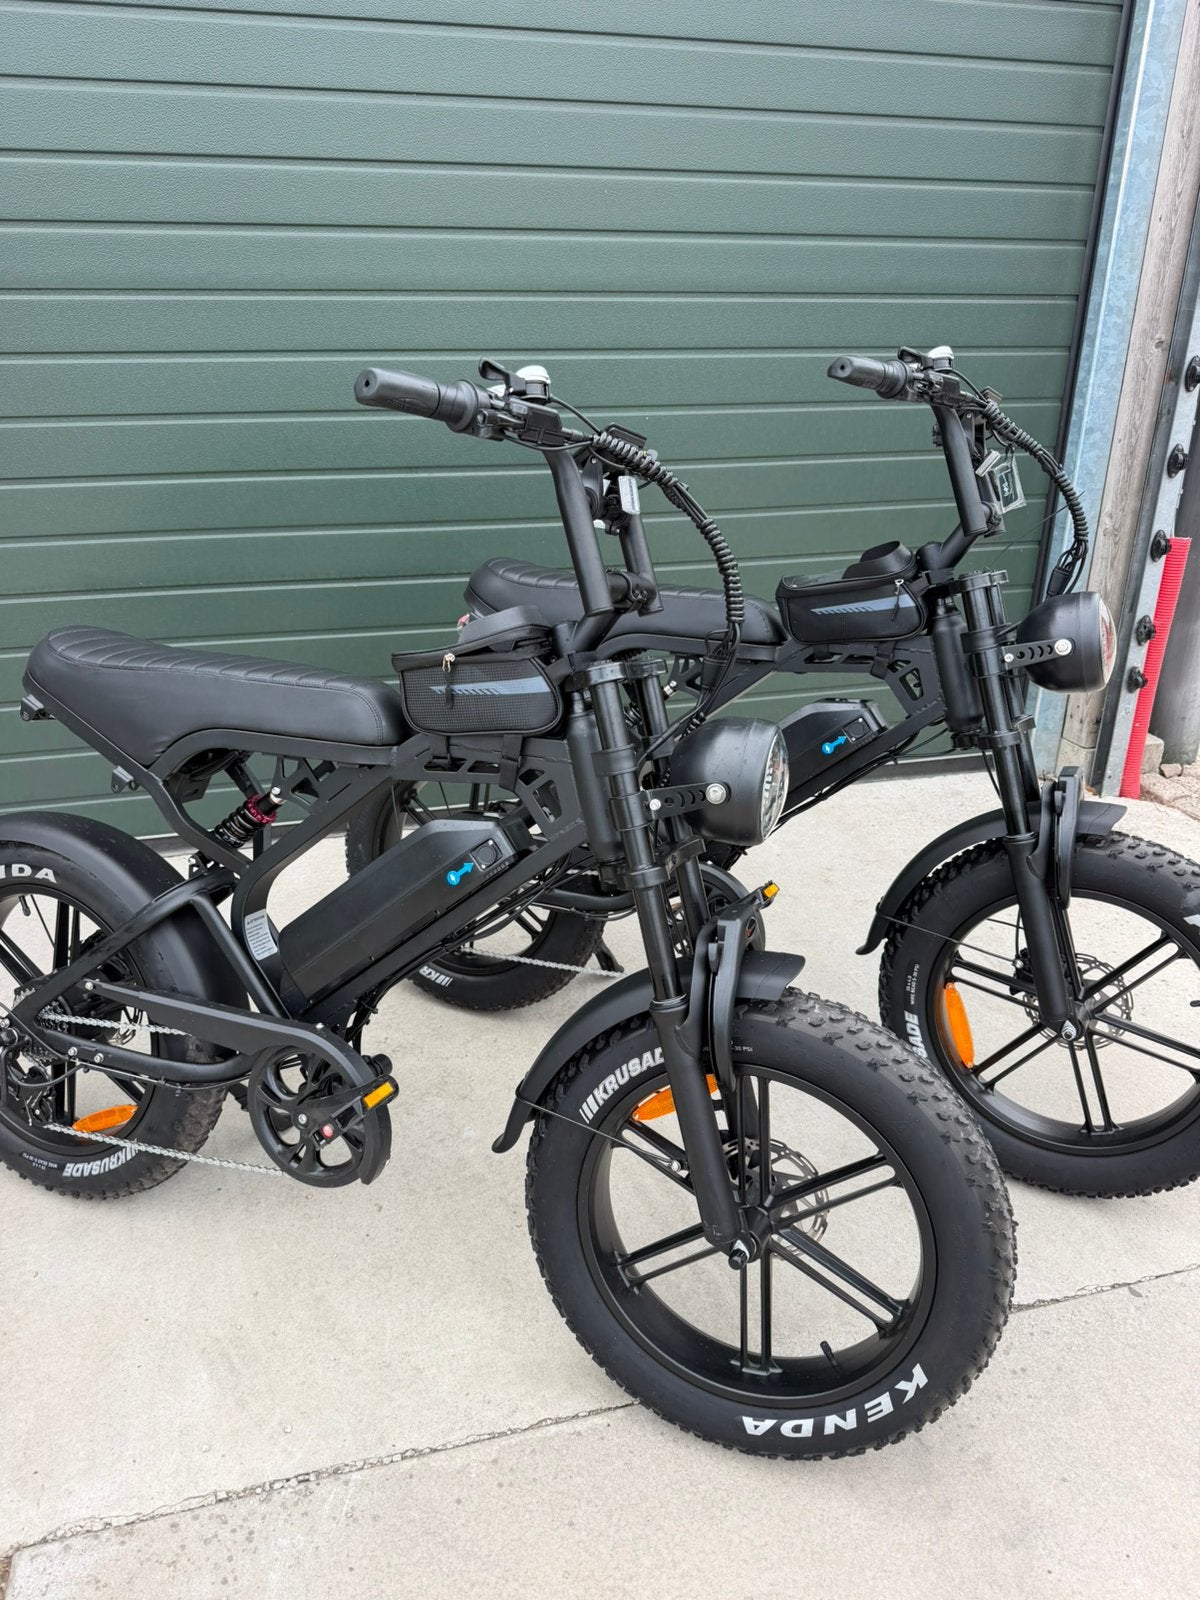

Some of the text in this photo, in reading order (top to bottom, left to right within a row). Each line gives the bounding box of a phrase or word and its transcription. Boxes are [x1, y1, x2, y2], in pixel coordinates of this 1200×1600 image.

[0, 863, 57, 884] DA
[62, 1147, 126, 1177] KRUSADE
[741, 1362, 929, 1438] KENDA
